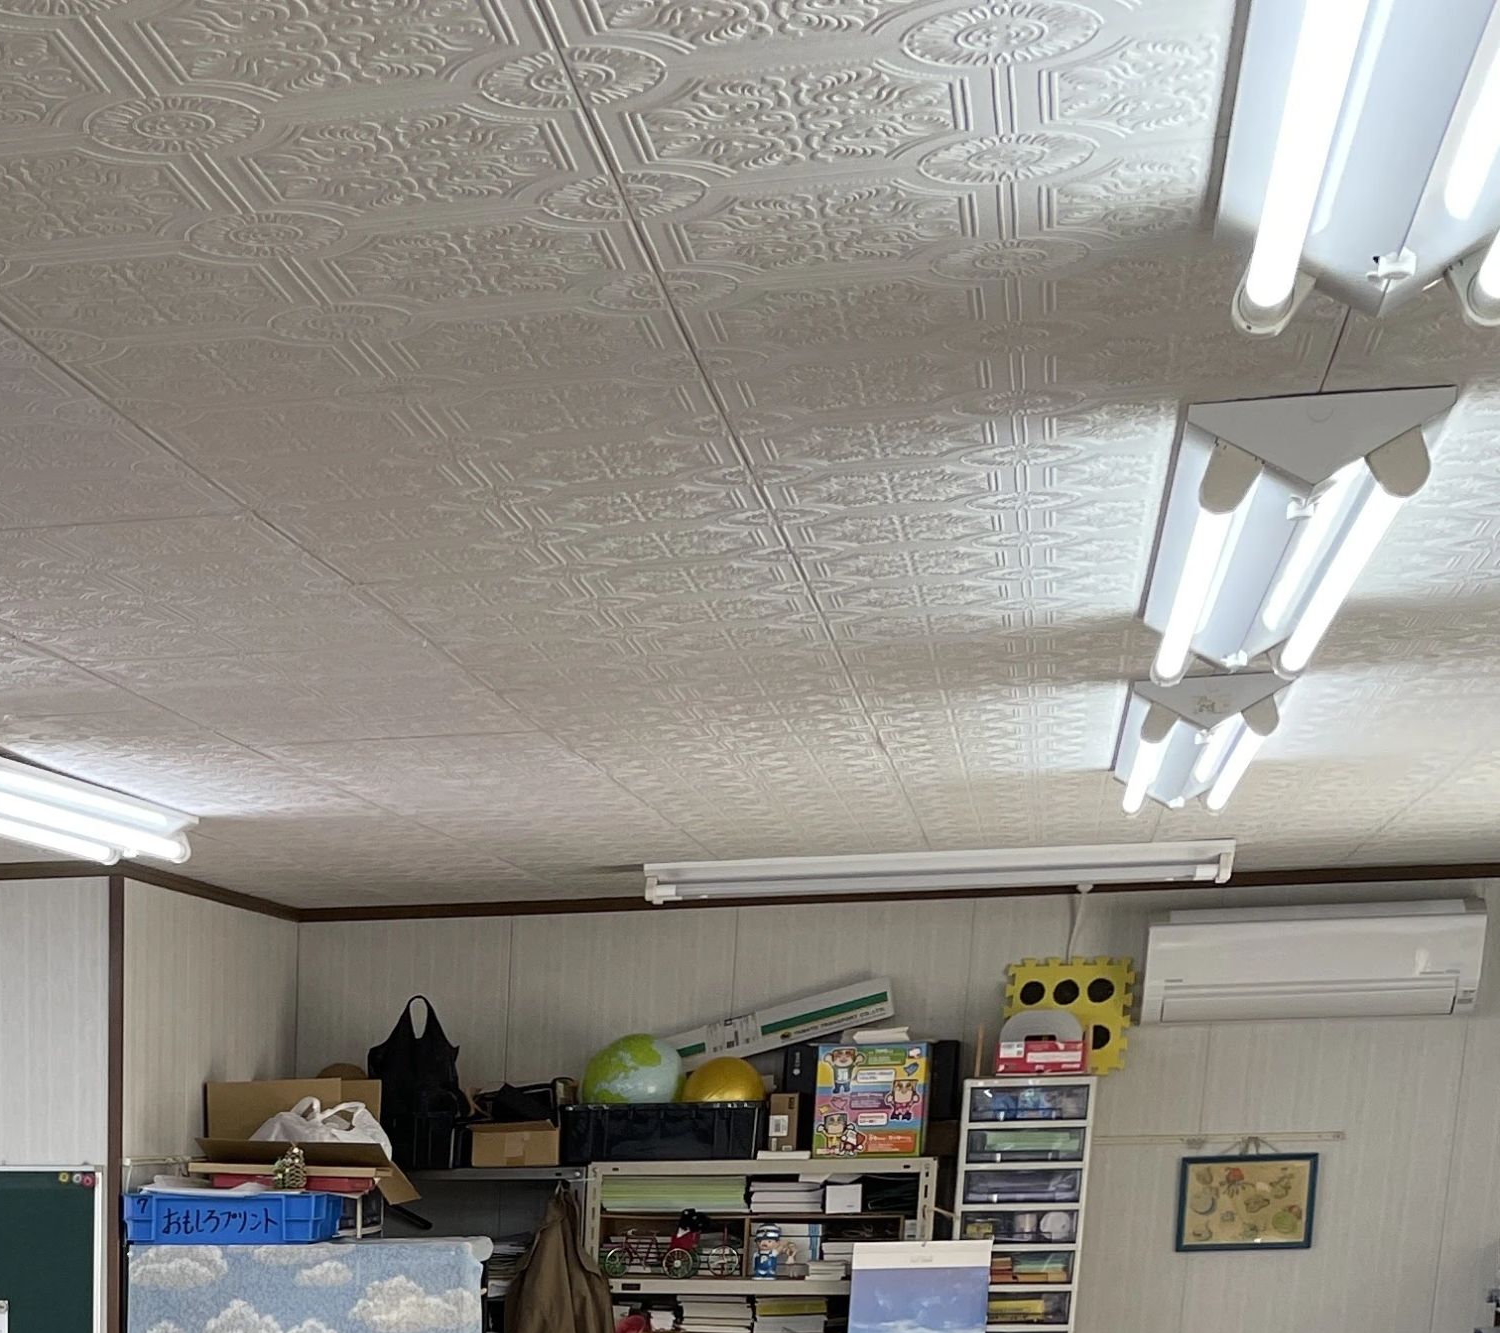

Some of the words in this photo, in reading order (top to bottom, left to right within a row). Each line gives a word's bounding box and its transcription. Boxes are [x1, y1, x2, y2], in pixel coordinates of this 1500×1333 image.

[137, 1197, 148, 1214] 7
[162, 1208, 278, 1235] おもしろプリント
